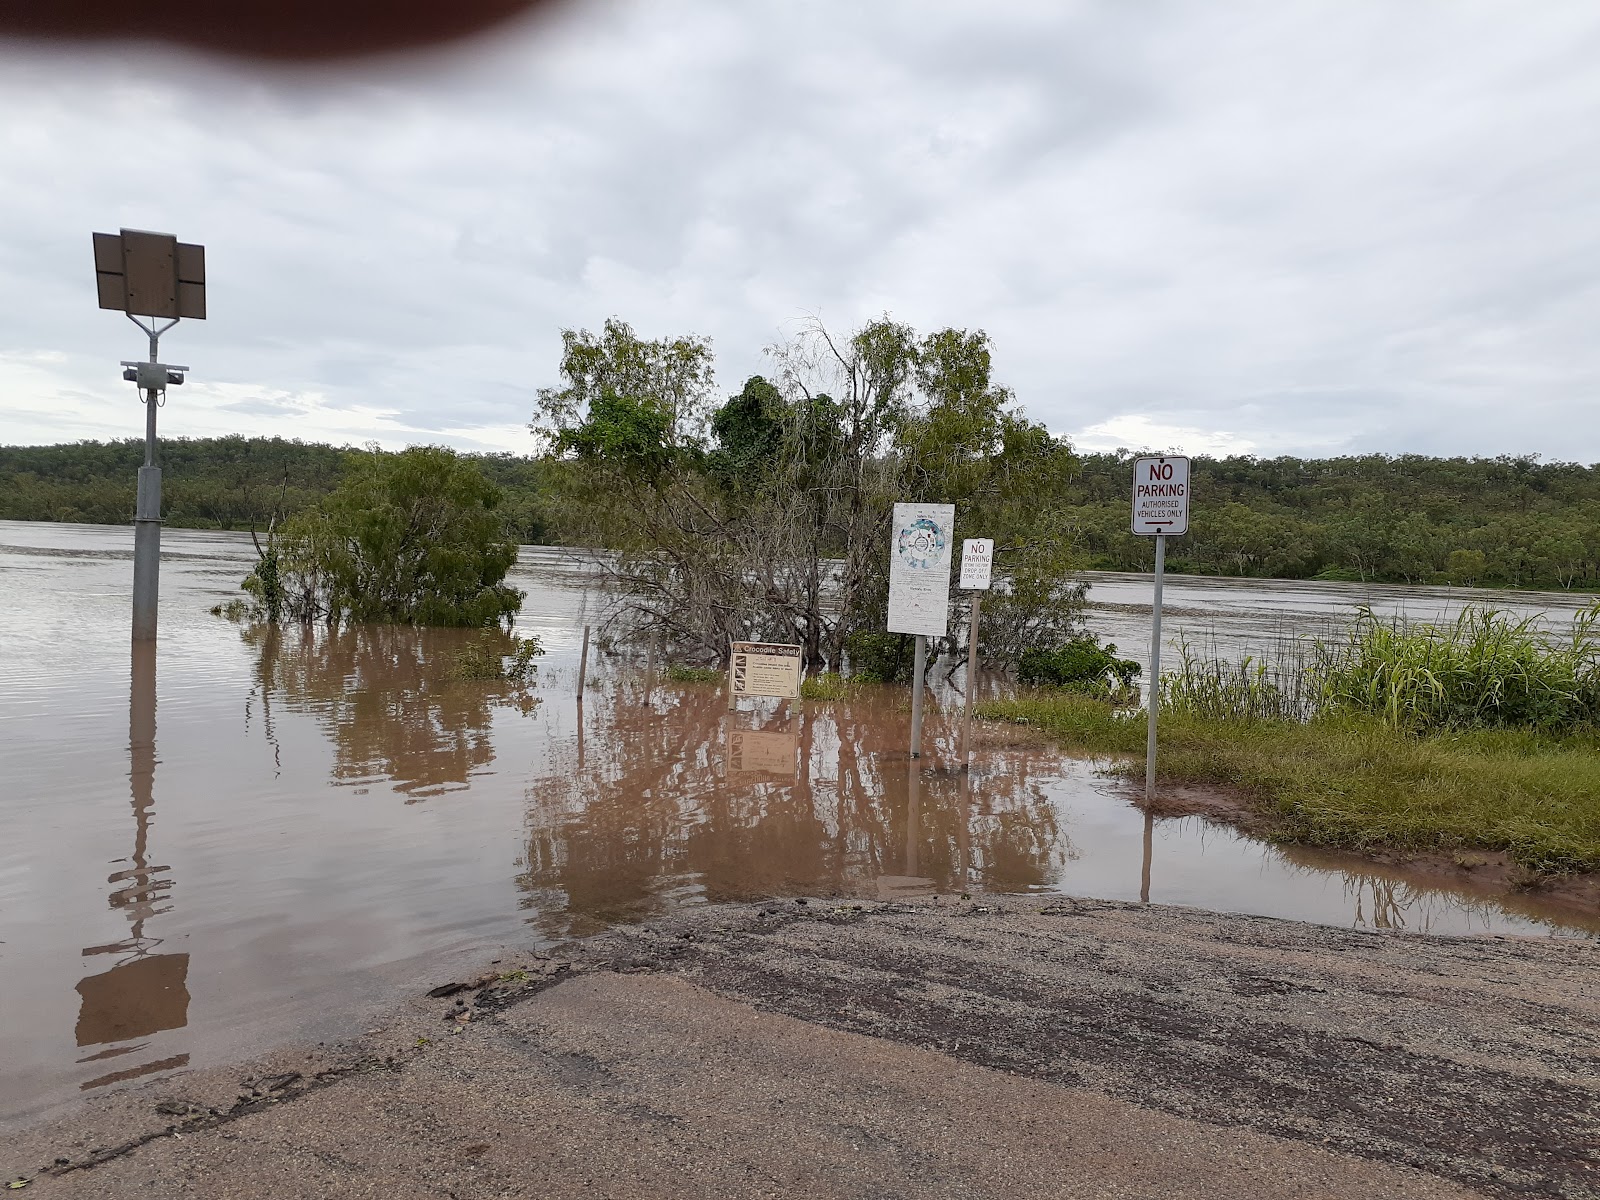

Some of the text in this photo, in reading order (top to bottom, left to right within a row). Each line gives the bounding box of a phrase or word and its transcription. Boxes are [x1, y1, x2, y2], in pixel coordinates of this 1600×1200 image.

[1149, 463, 1173, 481] NO
[1137, 483, 1185, 497] PARKING
[1141, 500, 1180, 508] AUTHORISED
[1137, 509, 1183, 518] VEHICLES ONLY
[971, 544, 984, 553] NO
[744, 645, 800, 656] Crocodile Safety
